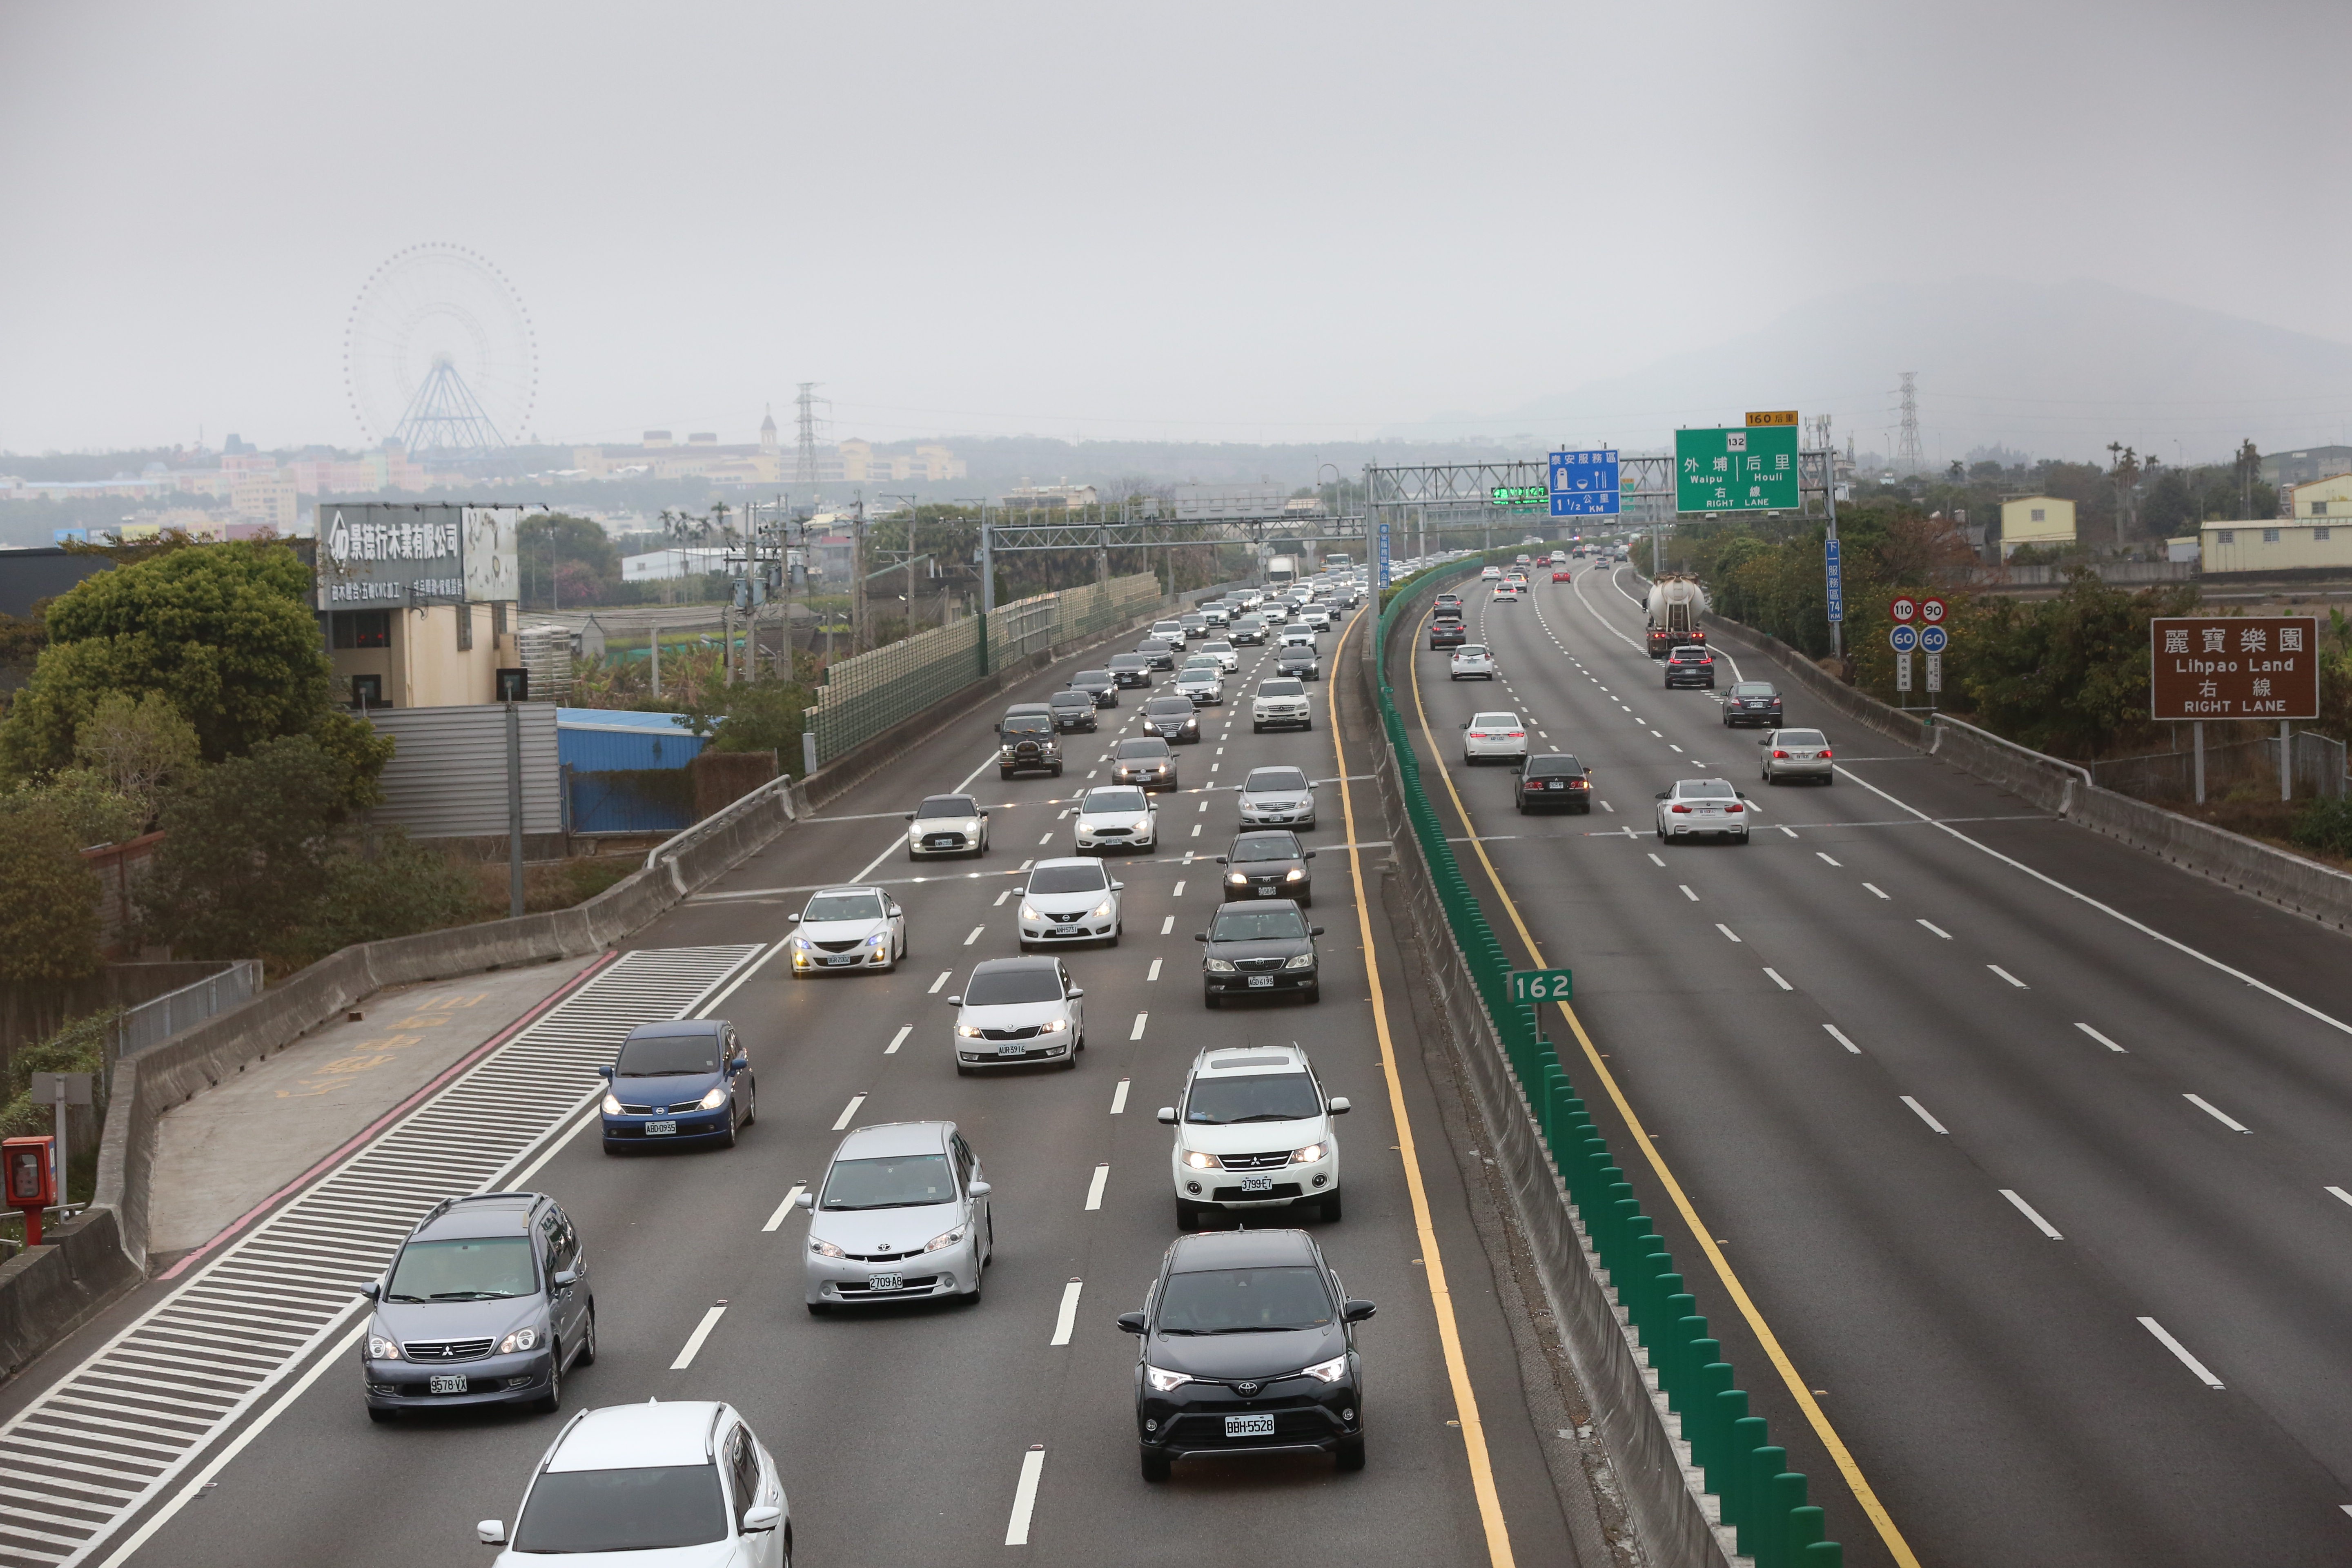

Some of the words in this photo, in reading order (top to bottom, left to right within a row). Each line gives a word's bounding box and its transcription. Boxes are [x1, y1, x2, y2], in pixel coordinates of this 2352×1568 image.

[1750, 414, 1771, 423] 160
[1775, 414, 1793, 423] 后里
[1551, 452, 1616, 465] 泰安服務區
[1684, 456, 1728, 472] 外埔
[1746, 454, 1790, 471] 后里
[1690, 475, 1722, 484] Waipu
[1755, 473, 1782, 481] Houli
[1583, 494, 1609, 503] 公里
[350, 523, 458, 561] 景德行木業有限公司
[1827, 541, 1839, 600] 下一服務區
[1829, 601, 1840, 612] 74
[1895, 605, 1911, 615] 110
[1925, 606, 1941, 616] 90
[1894, 633, 1913, 644] 60
[1924, 634, 1942, 645] 60
[2164, 628, 2303, 654] 麗寶樂園
[2176, 659, 2238, 675] Lihpao
[2249, 658, 2294, 672] Land
[2199, 678, 2271, 697] 右線
[2185, 700, 2231, 712] RIGHT
[2243, 700, 2286, 711] LANE
[1517, 975, 1568, 999] 162
[999, 1045, 1025, 1054] AUR-3916
[647, 1124, 675, 1132] ABD-0935
[1242, 1179, 1272, 1189] 3799-E7
[870, 1276, 902, 1288] 2709-A8
[431, 1379, 467, 1391] 9578-VX
[1227, 1420, 1273, 1433] BBH-5528
